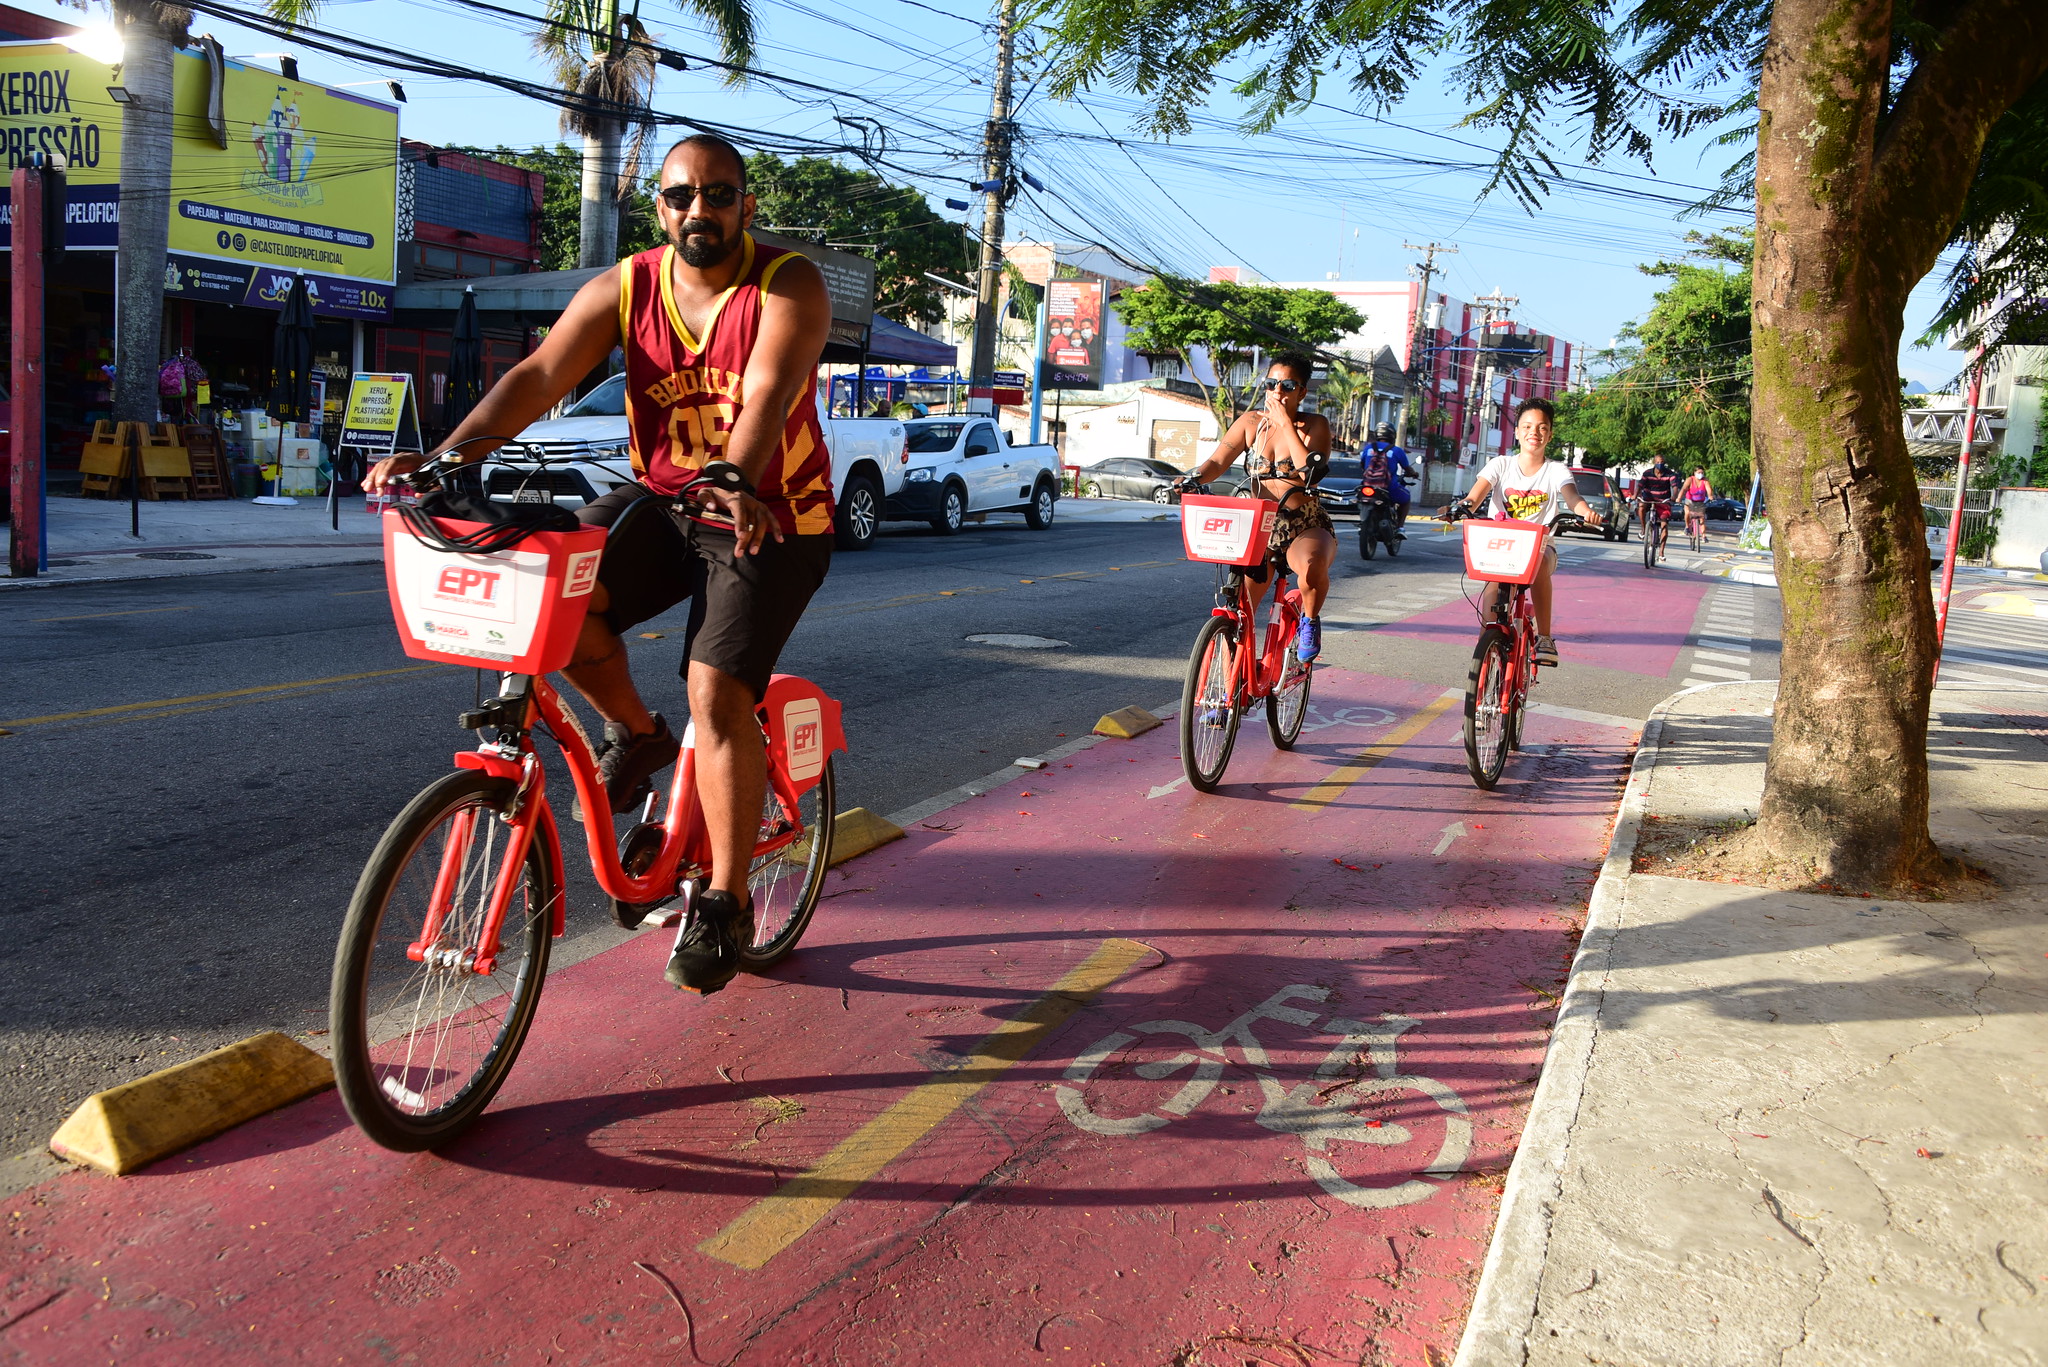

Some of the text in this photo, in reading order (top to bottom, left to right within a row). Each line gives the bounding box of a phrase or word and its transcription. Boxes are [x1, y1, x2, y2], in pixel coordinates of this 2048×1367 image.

[292, 184, 309, 199] Papel
[267, 196, 299, 209] PAPELARIA
[187, 205, 220, 219] PAPELARIA
[224, 211, 253, 226] MATERIAL
[253, 217, 268, 229] PARA
[250, 239, 344, 265] @CASTELODEPAPELOFICIAL
[271, 275, 319, 296] VOA
[360, 290, 387, 309] 10x
[361, 395, 392, 406] IMPRESSÃO
[369, 387, 388, 395] XEROX
[354, 406, 395, 417] PLASTIFICAÇÃO
[668, 403, 734, 471] 05
[1507, 493, 1549, 512] SUPER
[1513, 504, 1542, 521] GIRL
[1204, 518, 1233, 533] EPT
[1487, 538, 1516, 551] EPT
[573, 556, 597, 580] EPT
[437, 566, 501, 600] EPT
[794, 723, 817, 751] EPT
